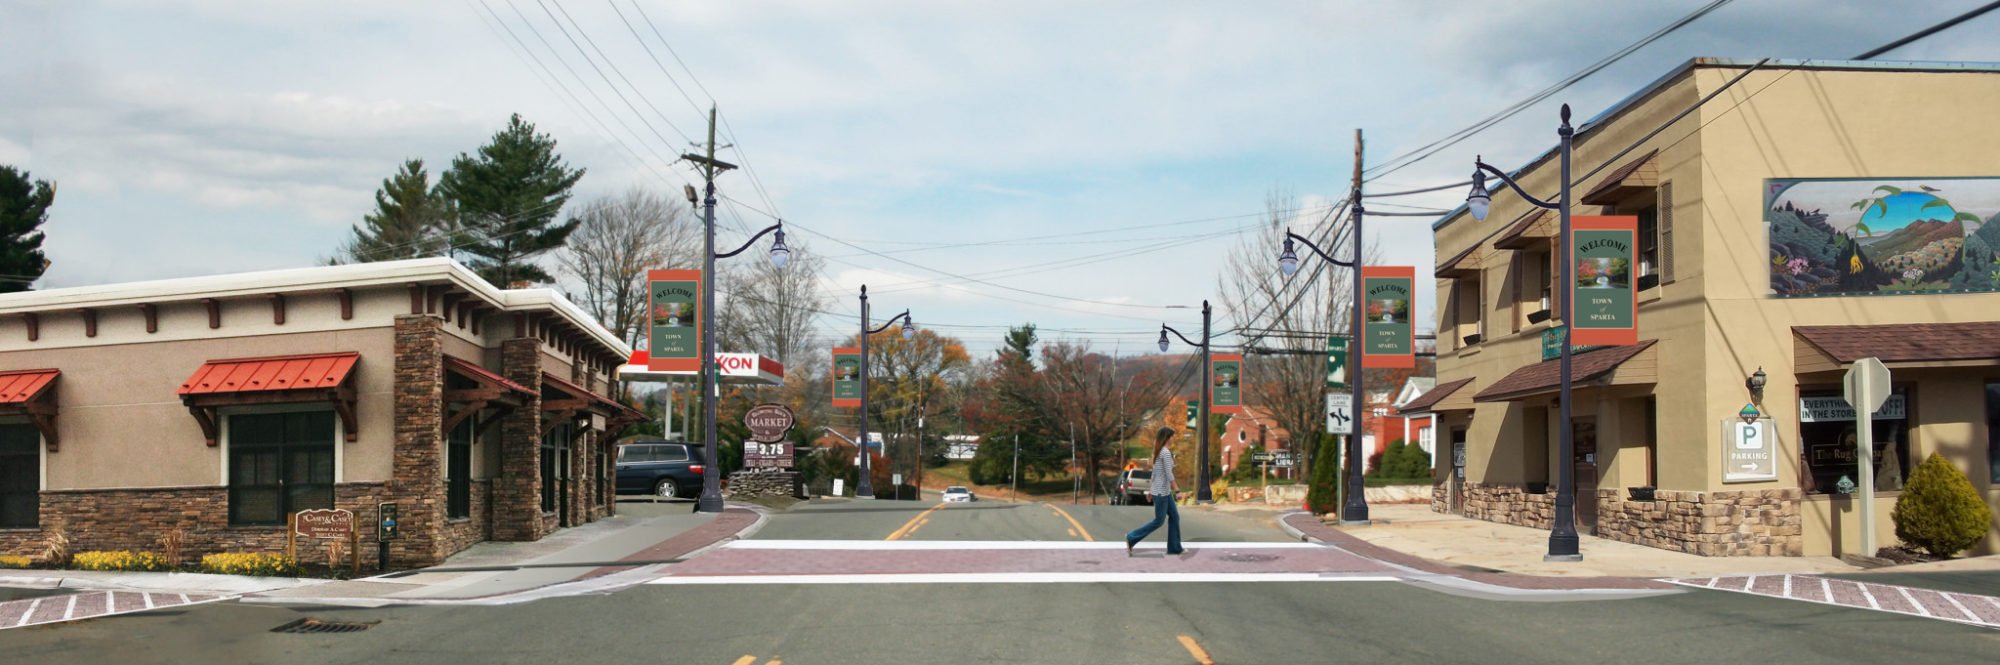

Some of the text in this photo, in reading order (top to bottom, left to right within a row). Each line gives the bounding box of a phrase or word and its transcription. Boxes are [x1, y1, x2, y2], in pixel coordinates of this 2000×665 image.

[1579, 238, 1628, 254] WELCOME
[656, 287, 693, 300] WELCOME
[1369, 284, 1407, 296] WELCOME
[1804, 399, 1855, 409] EVERYTHI
[1813, 410, 1829, 418] THE
[750, 418, 787, 427] MARKET
[1743, 426, 1757, 445] P
[759, 444, 784, 455] 3.75
[1731, 452, 1768, 460] PARKING
